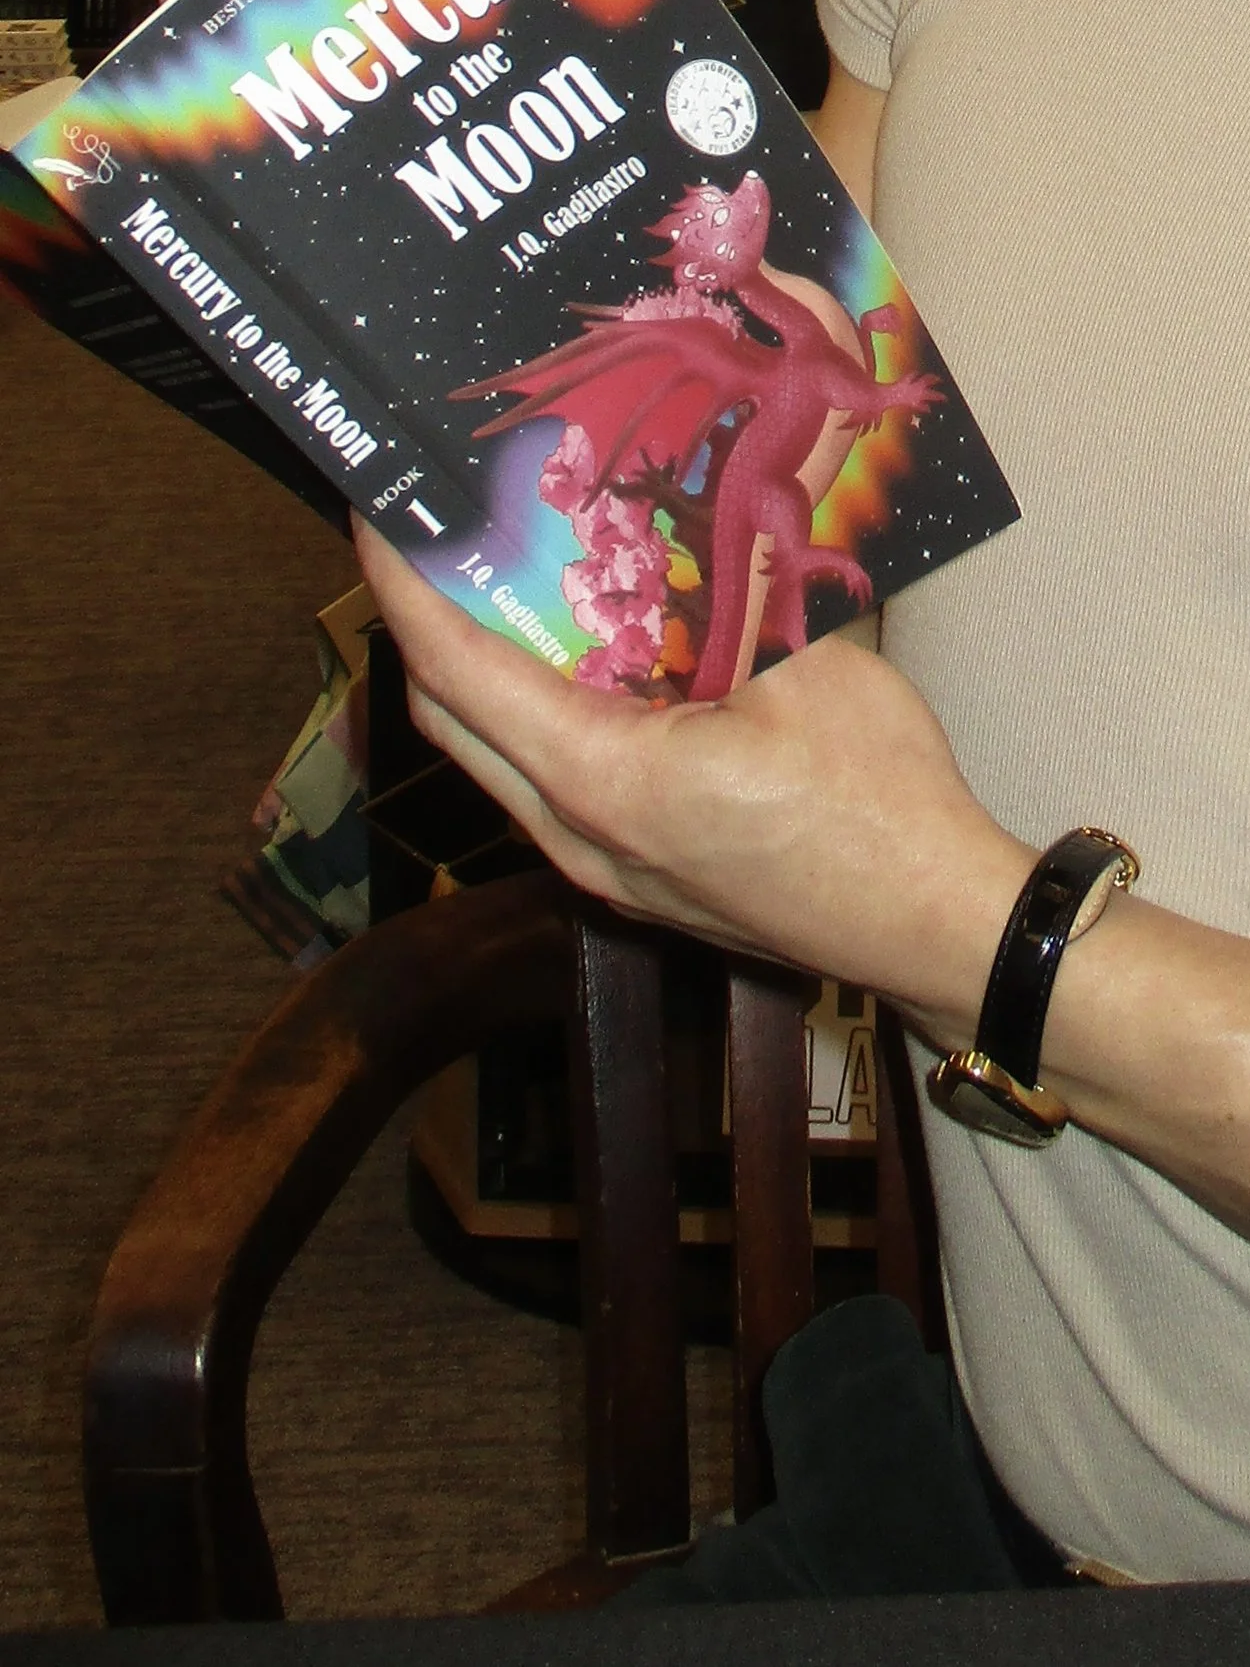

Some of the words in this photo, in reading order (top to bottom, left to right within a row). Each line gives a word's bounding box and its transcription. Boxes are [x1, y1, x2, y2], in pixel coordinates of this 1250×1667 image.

[412, 83, 458, 127] to
[448, 40, 514, 98] the
[394, 54, 627, 243] Moon
[500, 230, 549, 272] J.Q.
[542, 155, 649, 239] Gagliastro
[119, 197, 244, 322] Mercury
[226, 312, 264, 351] to
[251, 339, 302, 391] the
[292, 377, 380, 469] Moon
[373, 465, 425, 514] BOOK
[404, 497, 448, 539] 1
[455, 551, 495, 591] J.Q.
[490, 584, 571, 668] Gagliastro
